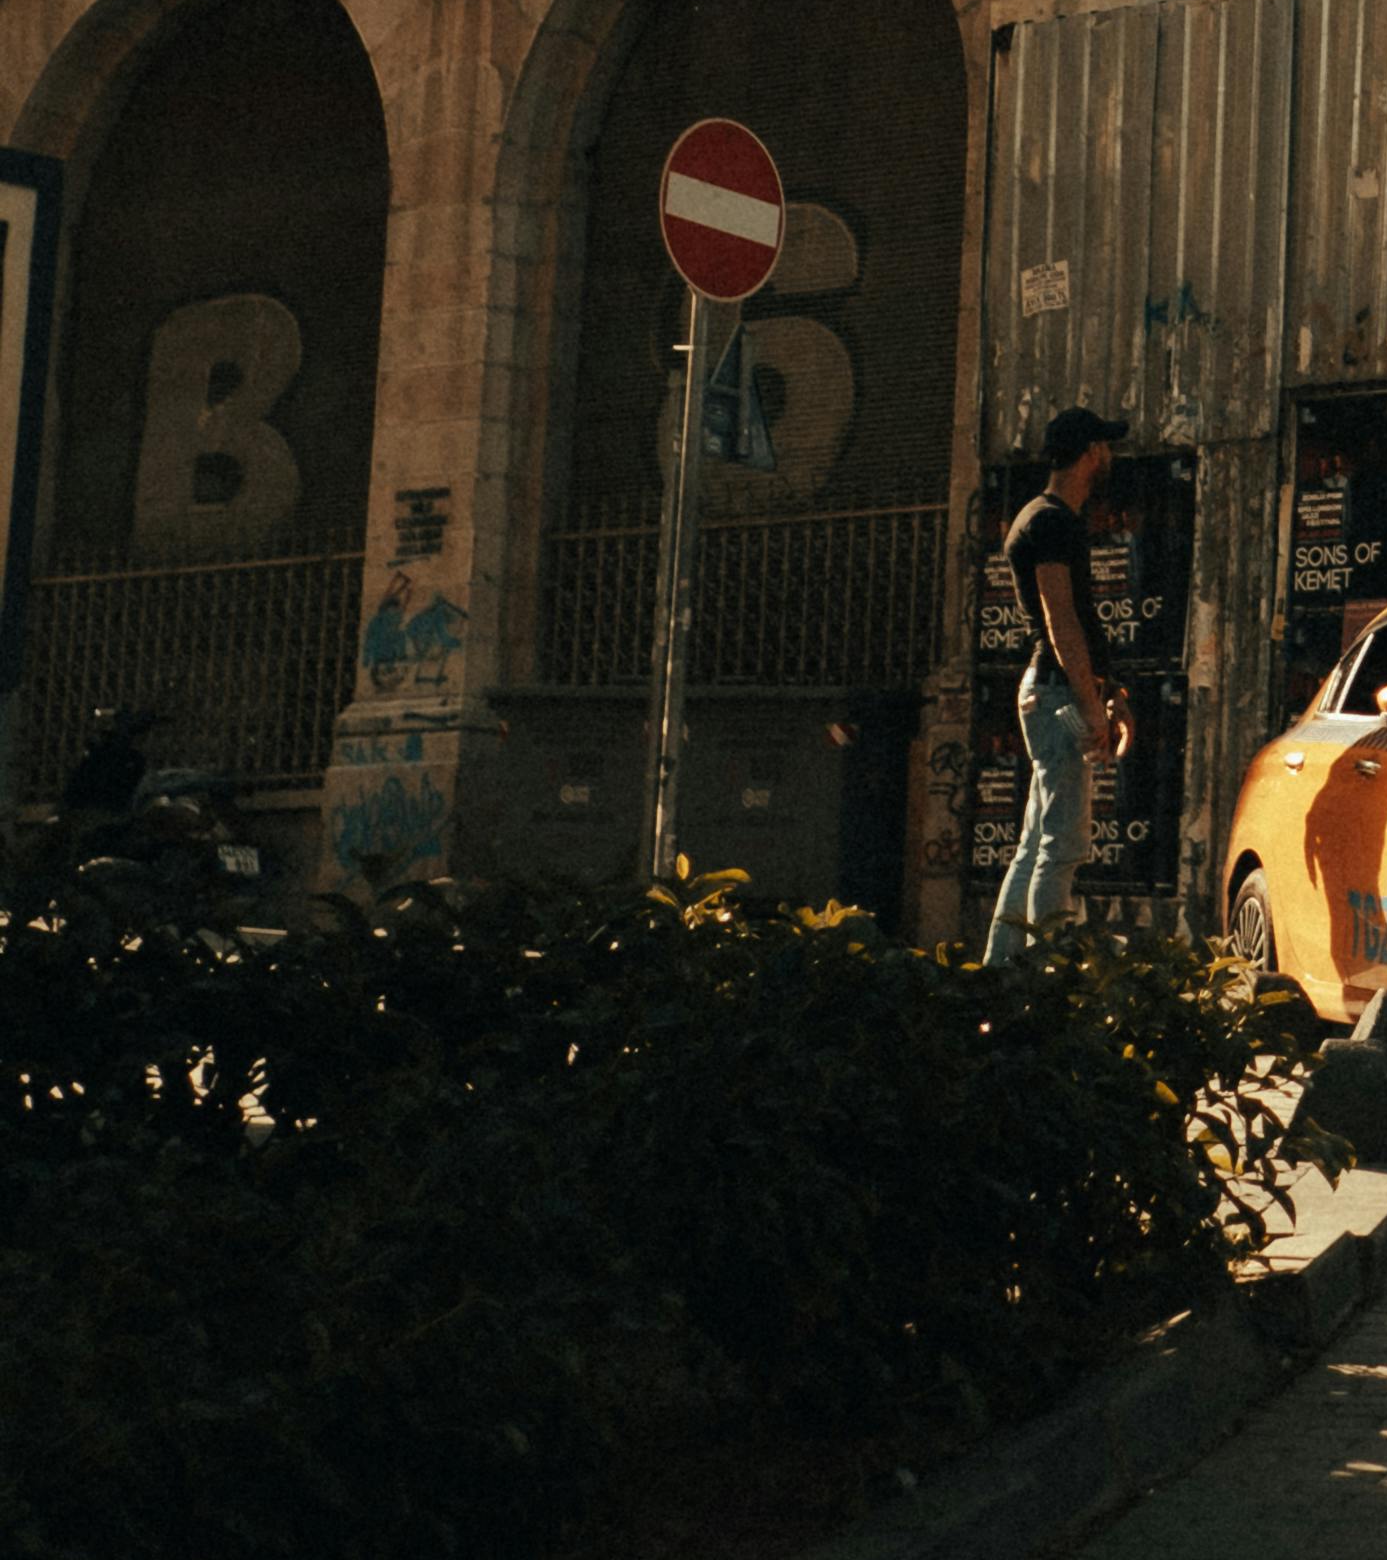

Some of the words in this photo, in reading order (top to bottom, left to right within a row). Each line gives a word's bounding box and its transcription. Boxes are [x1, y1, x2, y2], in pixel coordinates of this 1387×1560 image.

[1295, 544, 1349, 568] SONS
[1354, 541, 1383, 565] OF
[1294, 566, 1355, 592] KEMET
[1094, 597, 1134, 622] ONS
[1102, 620, 1141, 644] MET
[1091, 819, 1120, 841] ONS
[1088, 843, 1125, 865] MET
